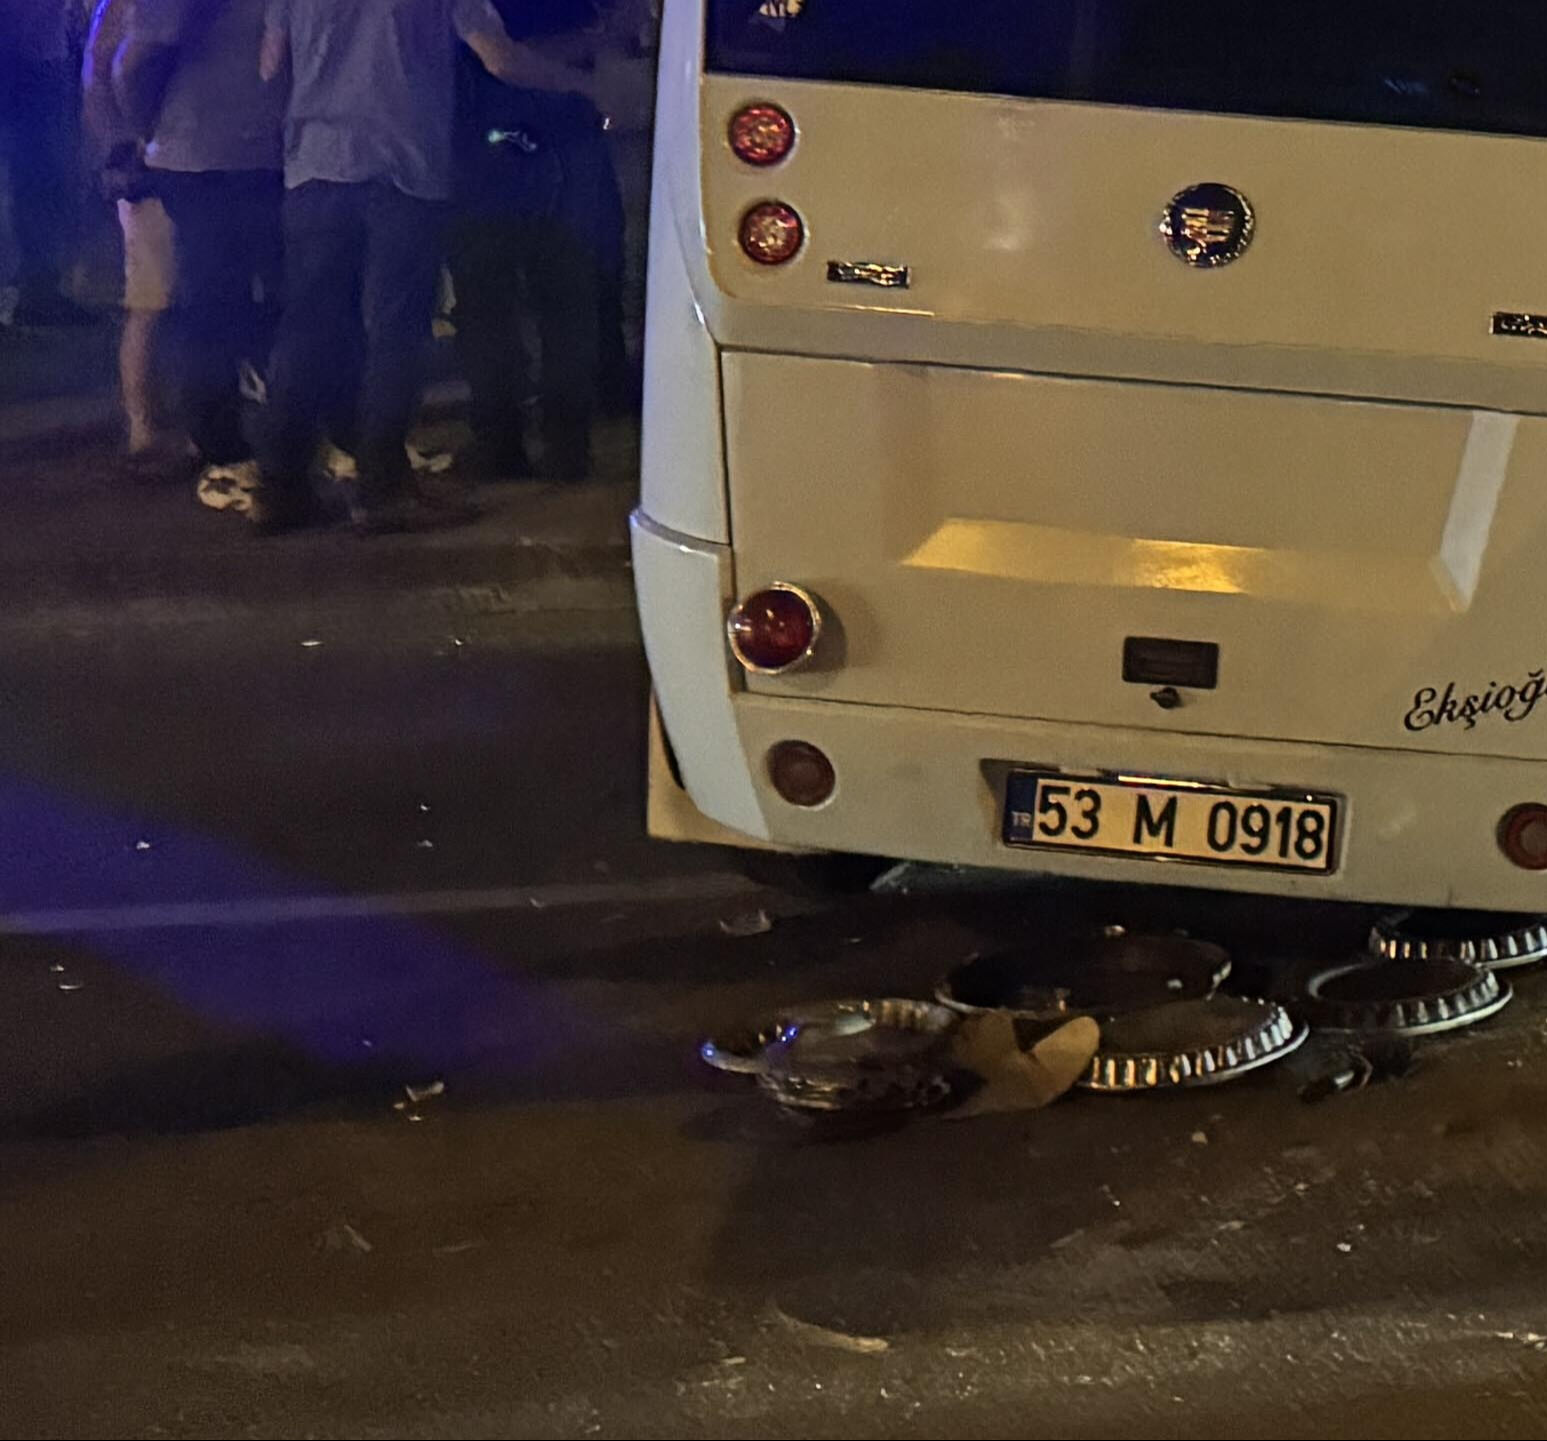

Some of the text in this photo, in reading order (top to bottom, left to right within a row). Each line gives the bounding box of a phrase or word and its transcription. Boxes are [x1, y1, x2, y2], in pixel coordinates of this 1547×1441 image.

[1010, 810, 1032, 828] TR
[1037, 784, 1326, 860] 53 M 0918
